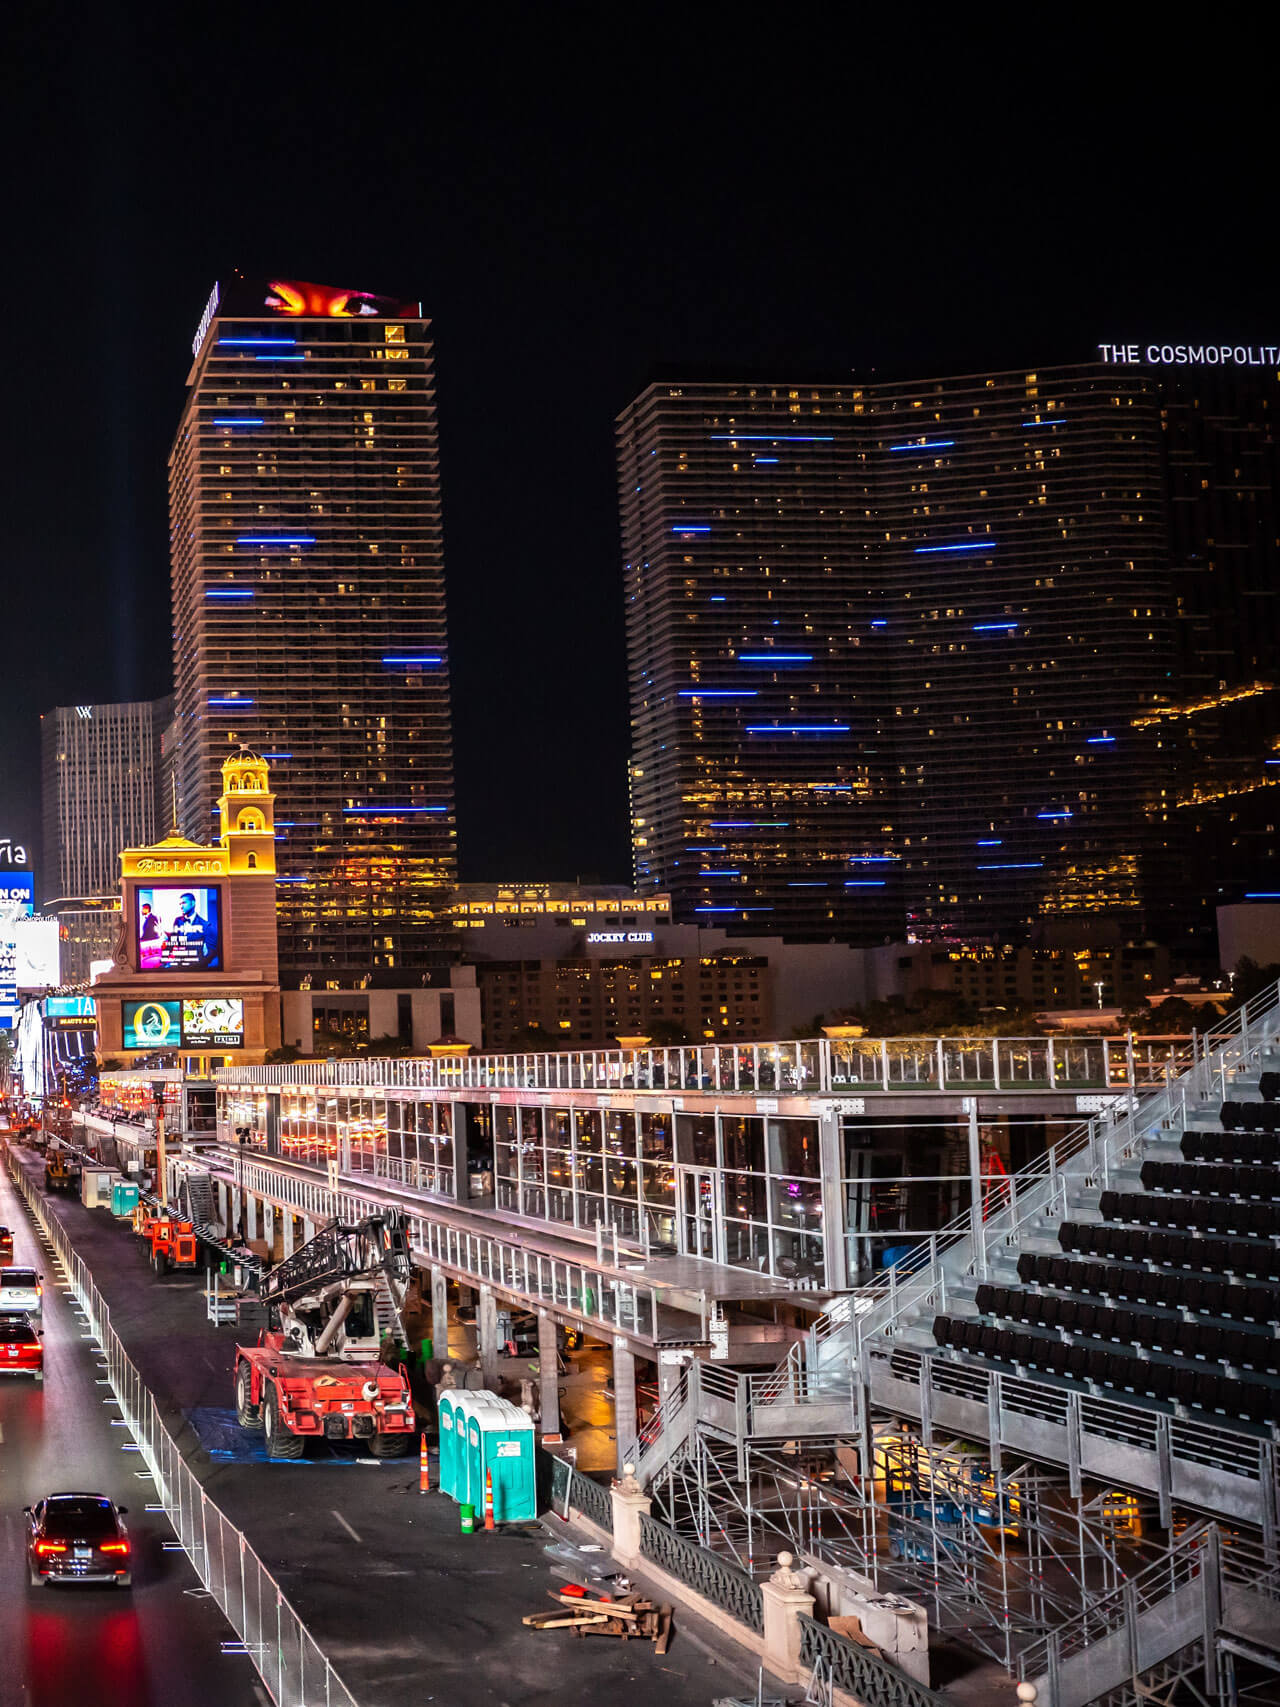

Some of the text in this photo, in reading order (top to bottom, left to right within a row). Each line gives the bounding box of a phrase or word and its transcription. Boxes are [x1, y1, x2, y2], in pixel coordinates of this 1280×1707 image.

[1098, 344, 1140, 363] THE
[136, 857, 223, 873] BELLAGIO
[10, 888, 31, 900] ON
[587, 932, 653, 943] JOCKEY CLUB
